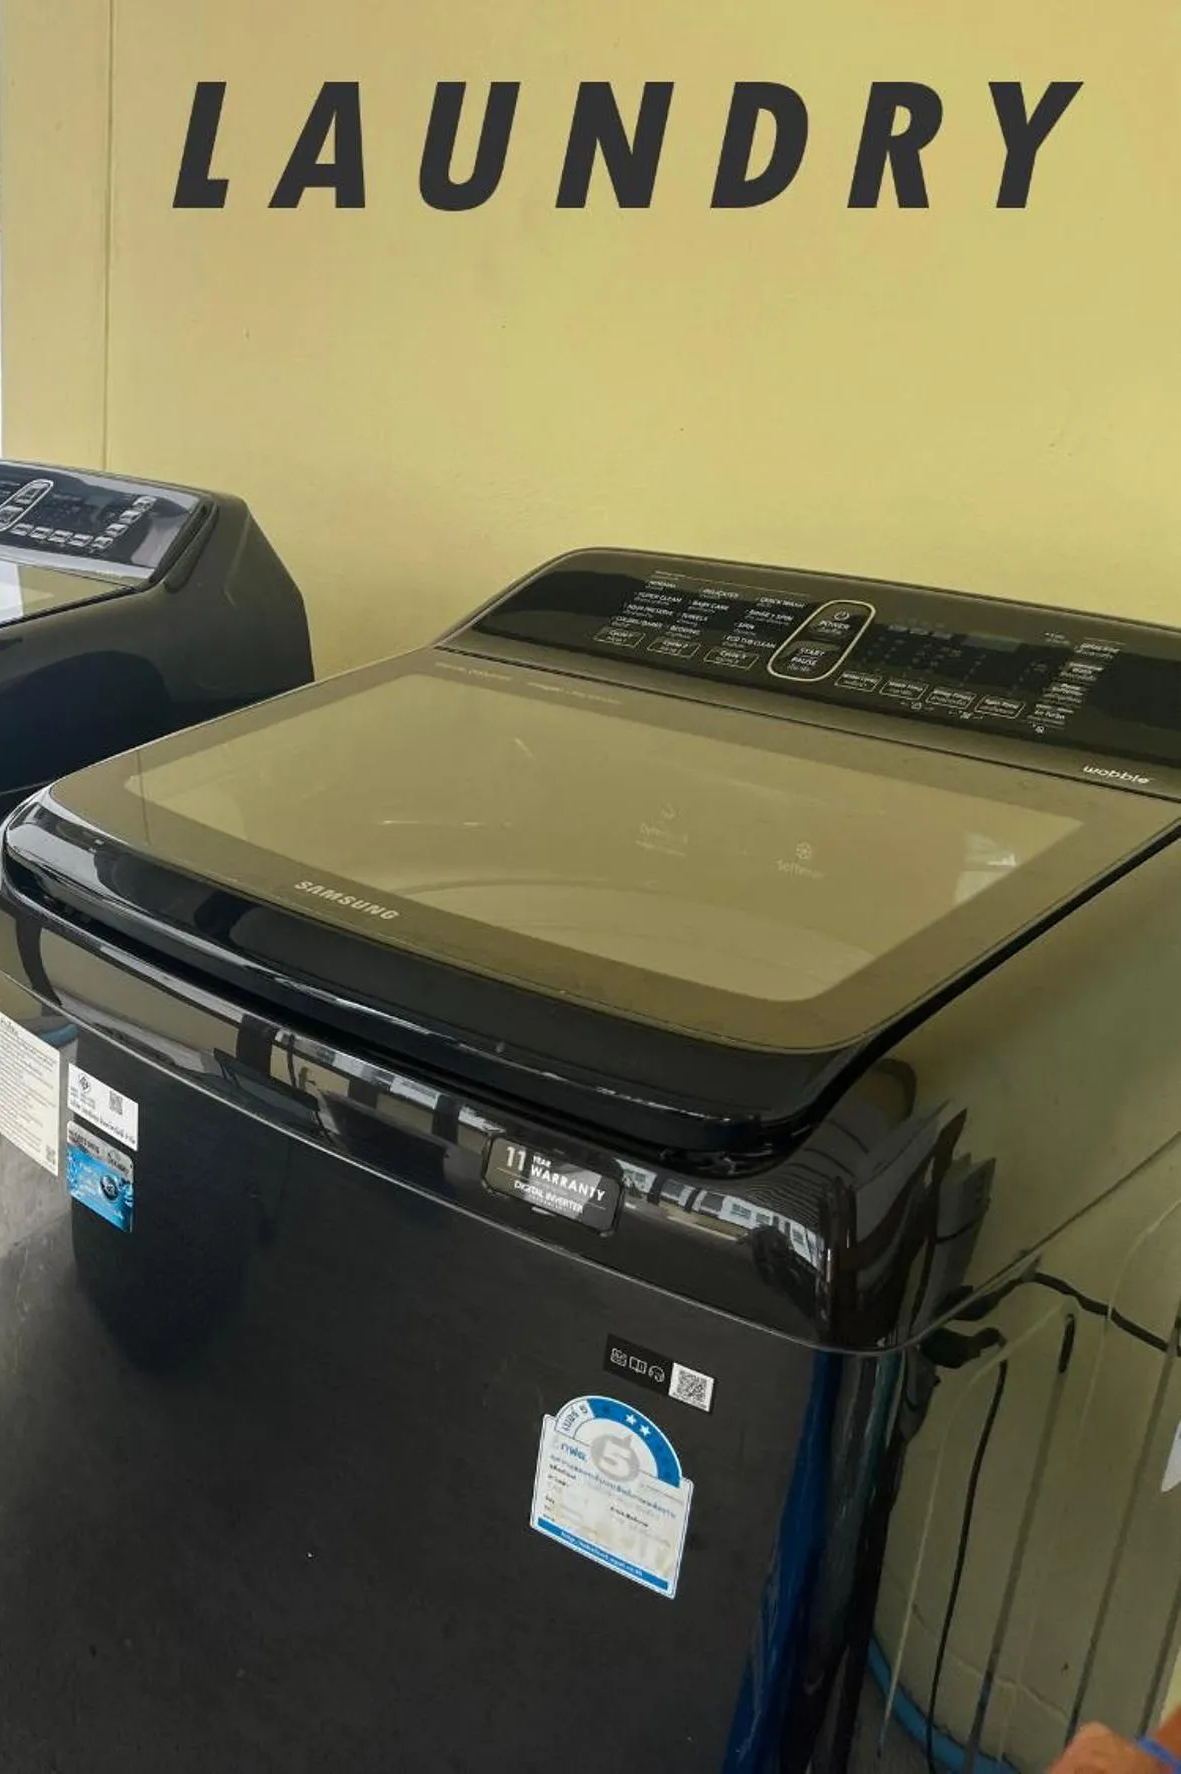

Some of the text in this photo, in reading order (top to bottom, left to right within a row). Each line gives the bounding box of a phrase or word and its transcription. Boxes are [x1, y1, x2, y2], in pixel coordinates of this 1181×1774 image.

[1082, 764, 1151, 785] wobble
[294, 880, 400, 920] SAMSUNG
[506, 1146, 527, 1172] 11
[532, 1154, 552, 1168] YEAR
[530, 1163, 606, 1202] WARRANTY
